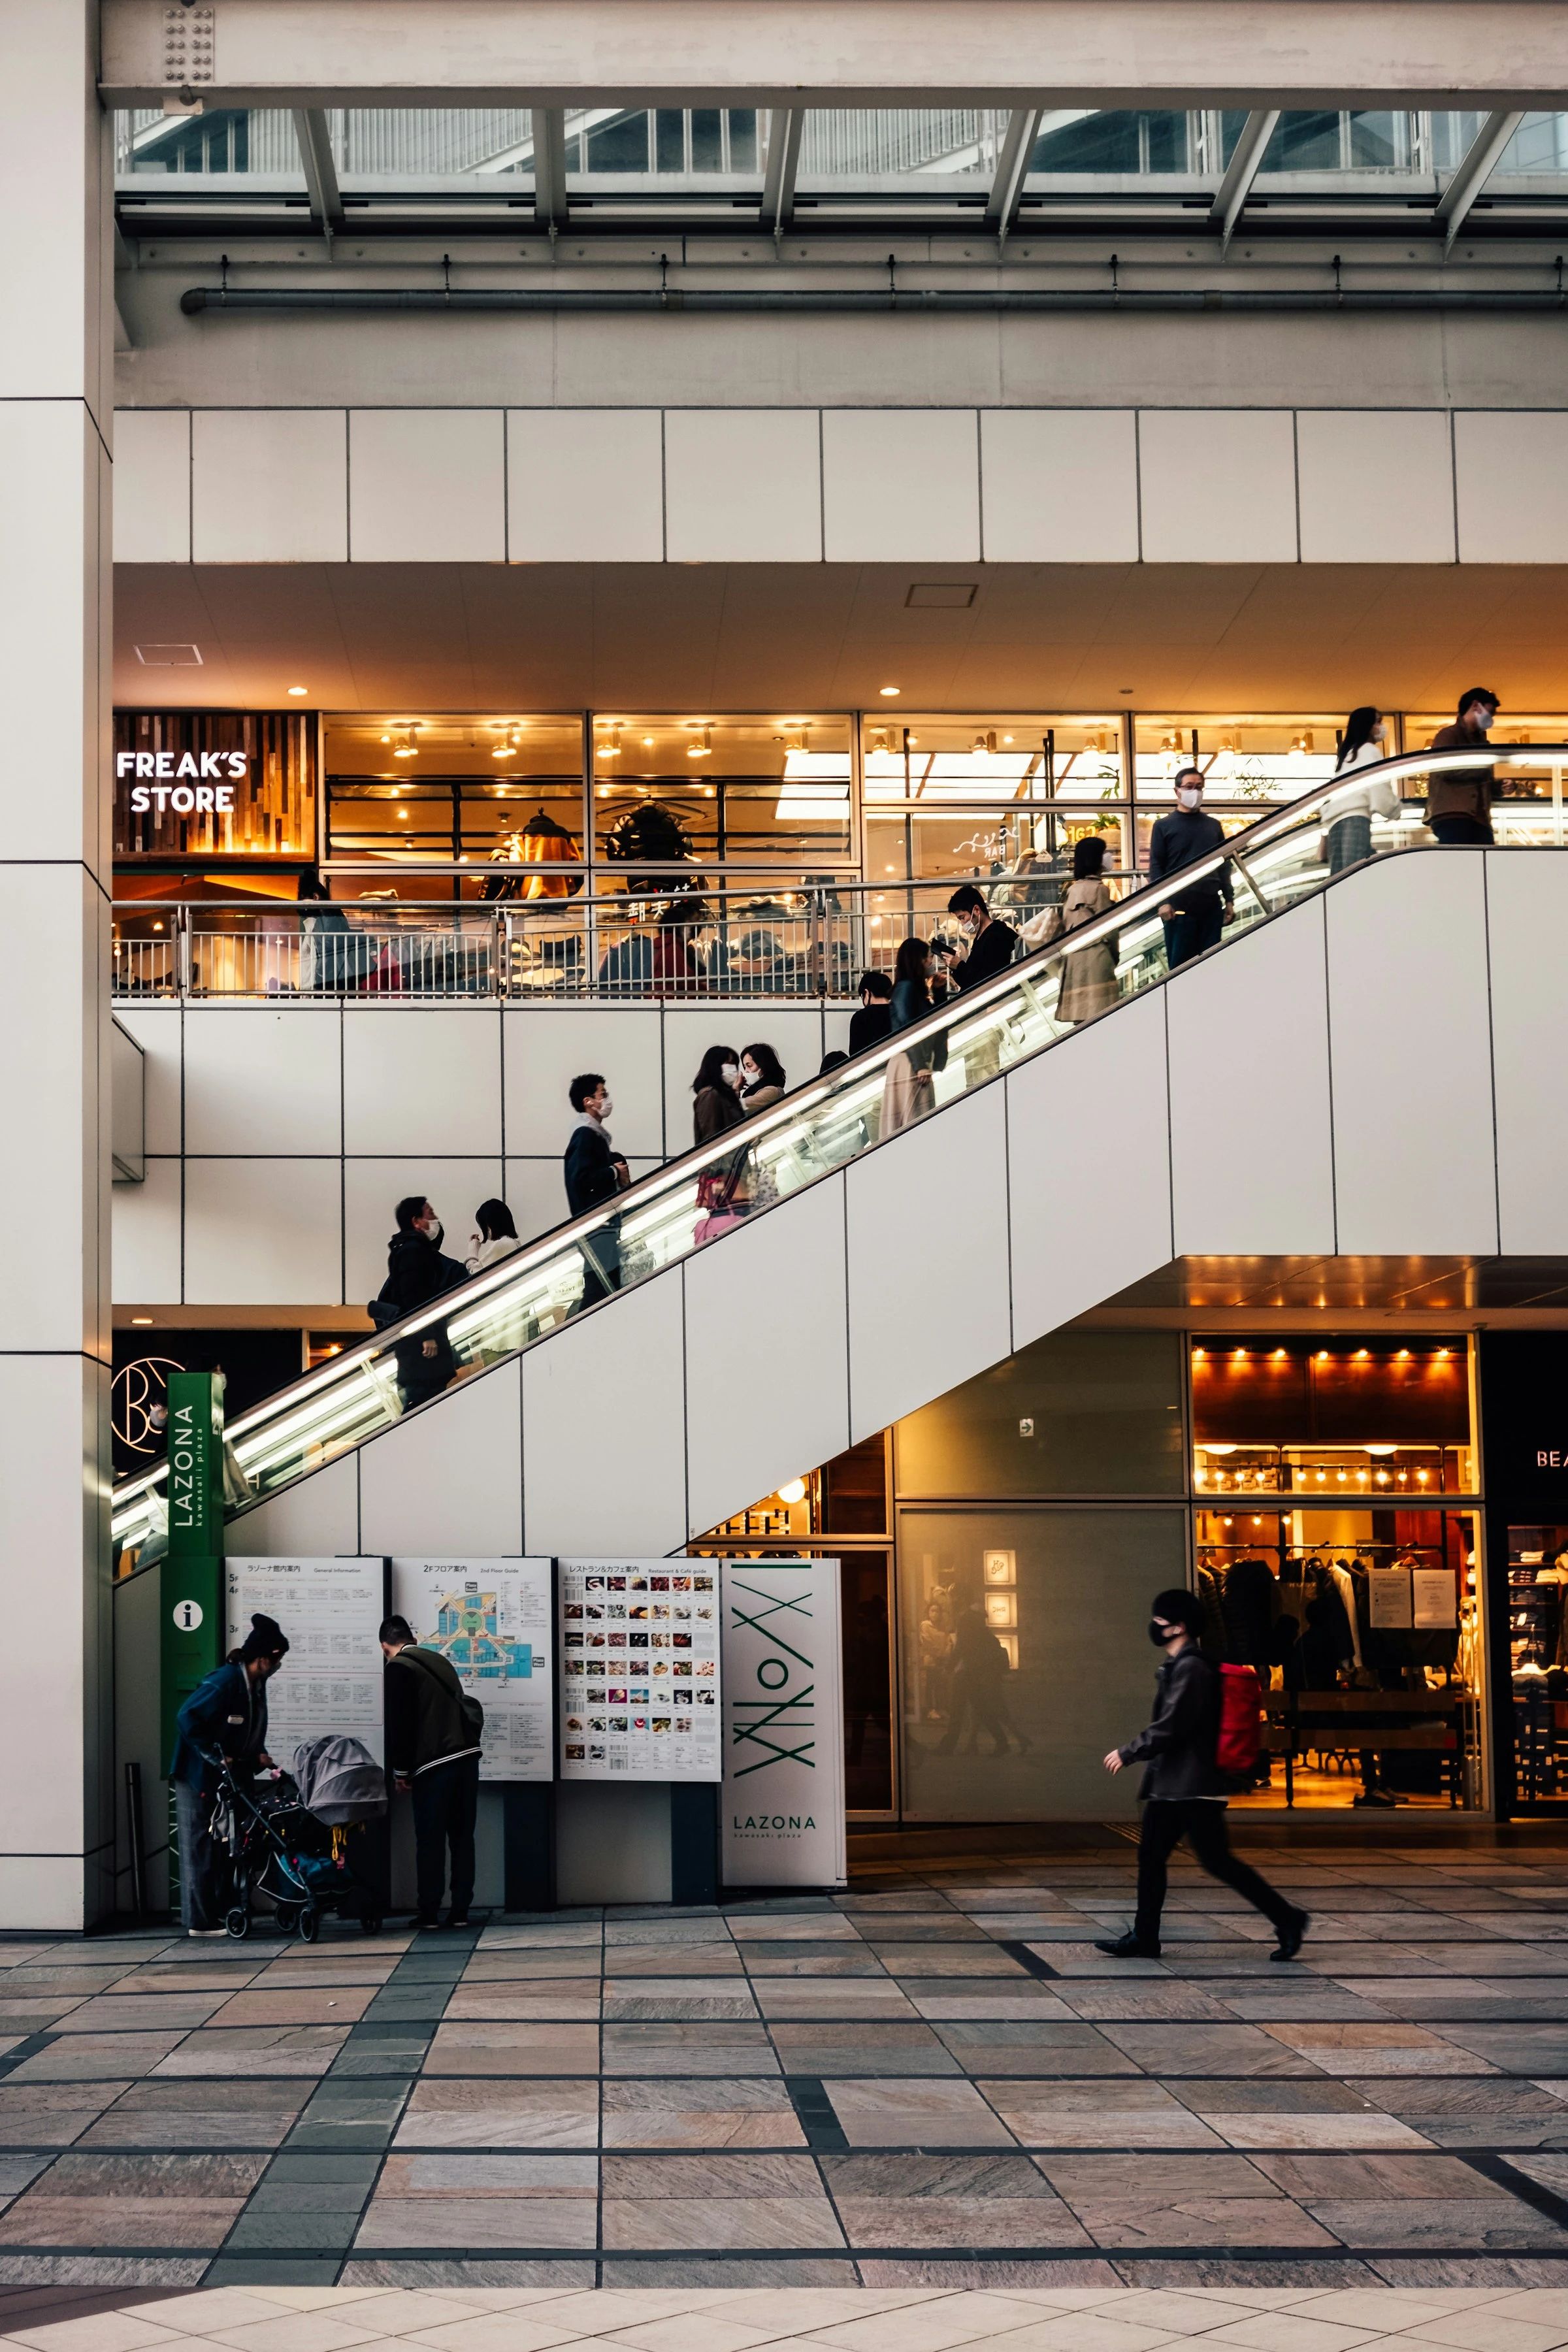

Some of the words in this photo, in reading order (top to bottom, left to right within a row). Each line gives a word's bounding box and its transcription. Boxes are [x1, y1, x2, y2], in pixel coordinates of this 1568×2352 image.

[116, 751, 247, 778] FREAK'S
[131, 786, 234, 813] STORE
[195, 1428, 204, 1462] plaza
[174, 1405, 193, 1527] LAZONA
[734, 1816, 816, 1829] LAZONA
